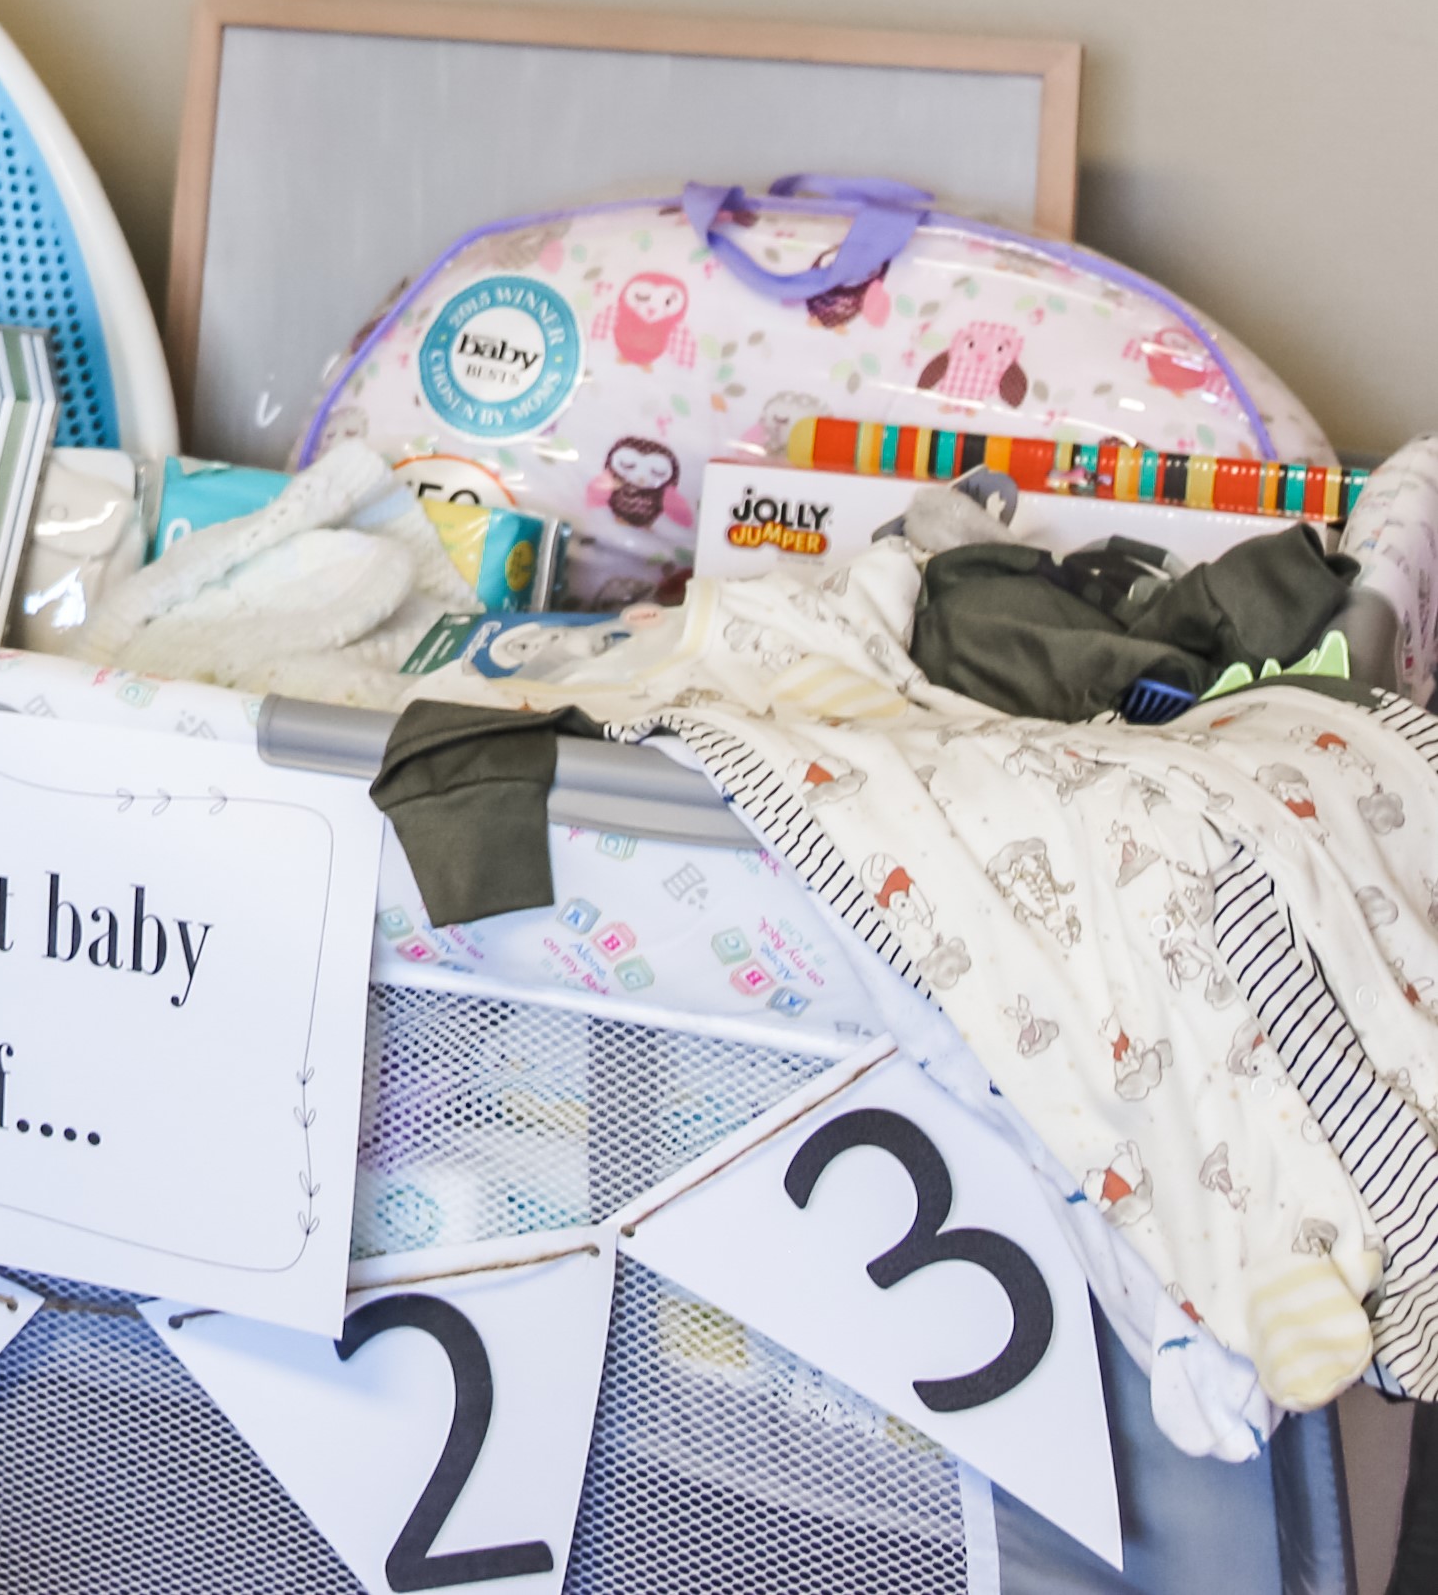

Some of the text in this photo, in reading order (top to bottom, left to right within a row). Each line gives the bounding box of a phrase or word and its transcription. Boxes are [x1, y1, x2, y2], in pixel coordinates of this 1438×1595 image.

[496, 286, 566, 346] WINNER
[457, 332, 540, 370] baby
[465, 364, 521, 384] BESTS
[480, 408, 507, 426] BY
[730, 522, 823, 554] JUMPER
[41, 871, 214, 1008] baby
[333, 1293, 554, 1593] 2
[784, 1108, 1054, 1412] 3
